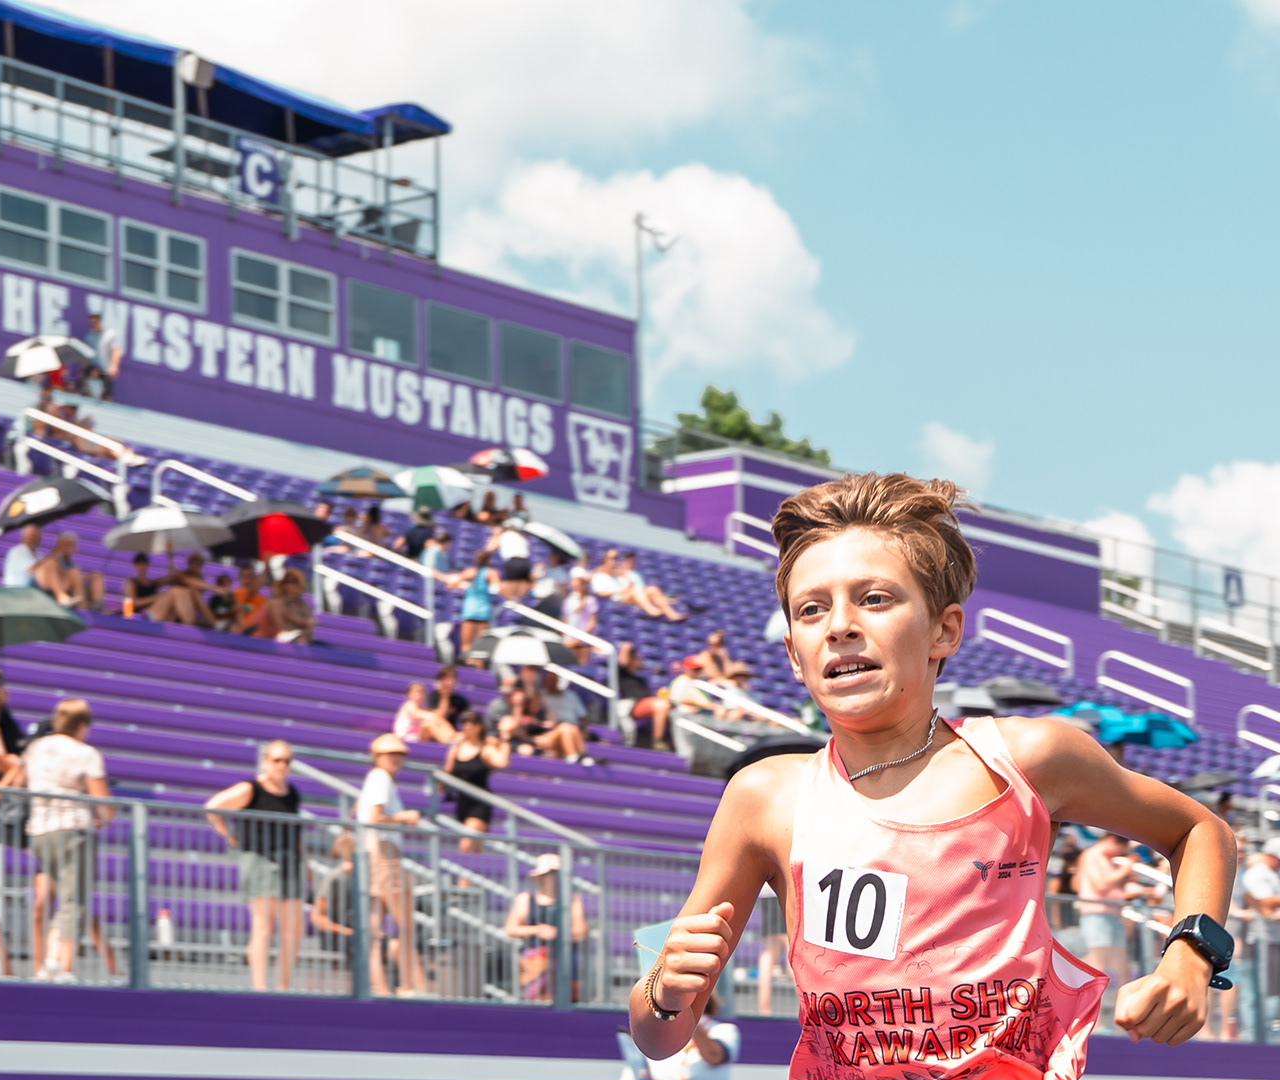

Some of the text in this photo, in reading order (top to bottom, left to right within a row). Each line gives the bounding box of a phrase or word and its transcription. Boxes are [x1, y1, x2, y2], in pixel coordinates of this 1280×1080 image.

[245, 151, 274, 198] C
[331, 352, 554, 454] MUSTANGS
[818, 868, 887, 950] 10
[803, 986, 934, 1027] NORTH
